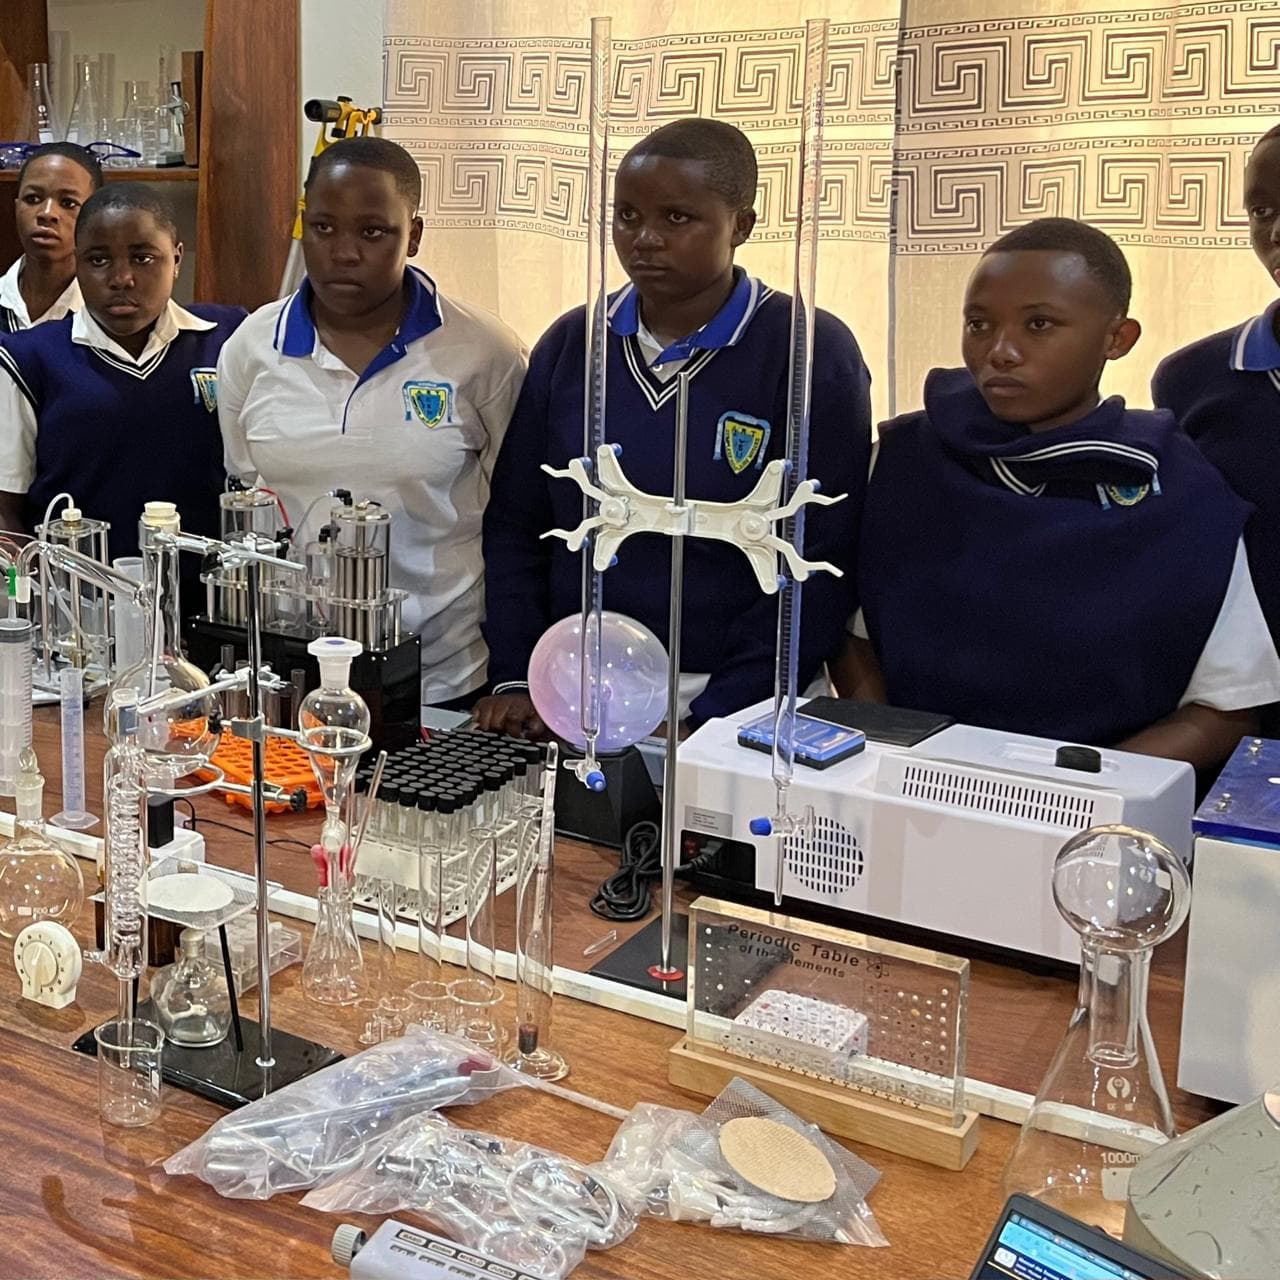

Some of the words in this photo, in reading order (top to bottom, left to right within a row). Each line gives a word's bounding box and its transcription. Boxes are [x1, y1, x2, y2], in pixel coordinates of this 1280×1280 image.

[728, 924, 801, 952] Periodic
[811, 944, 860, 967] Table
[739, 944, 752, 954] of
